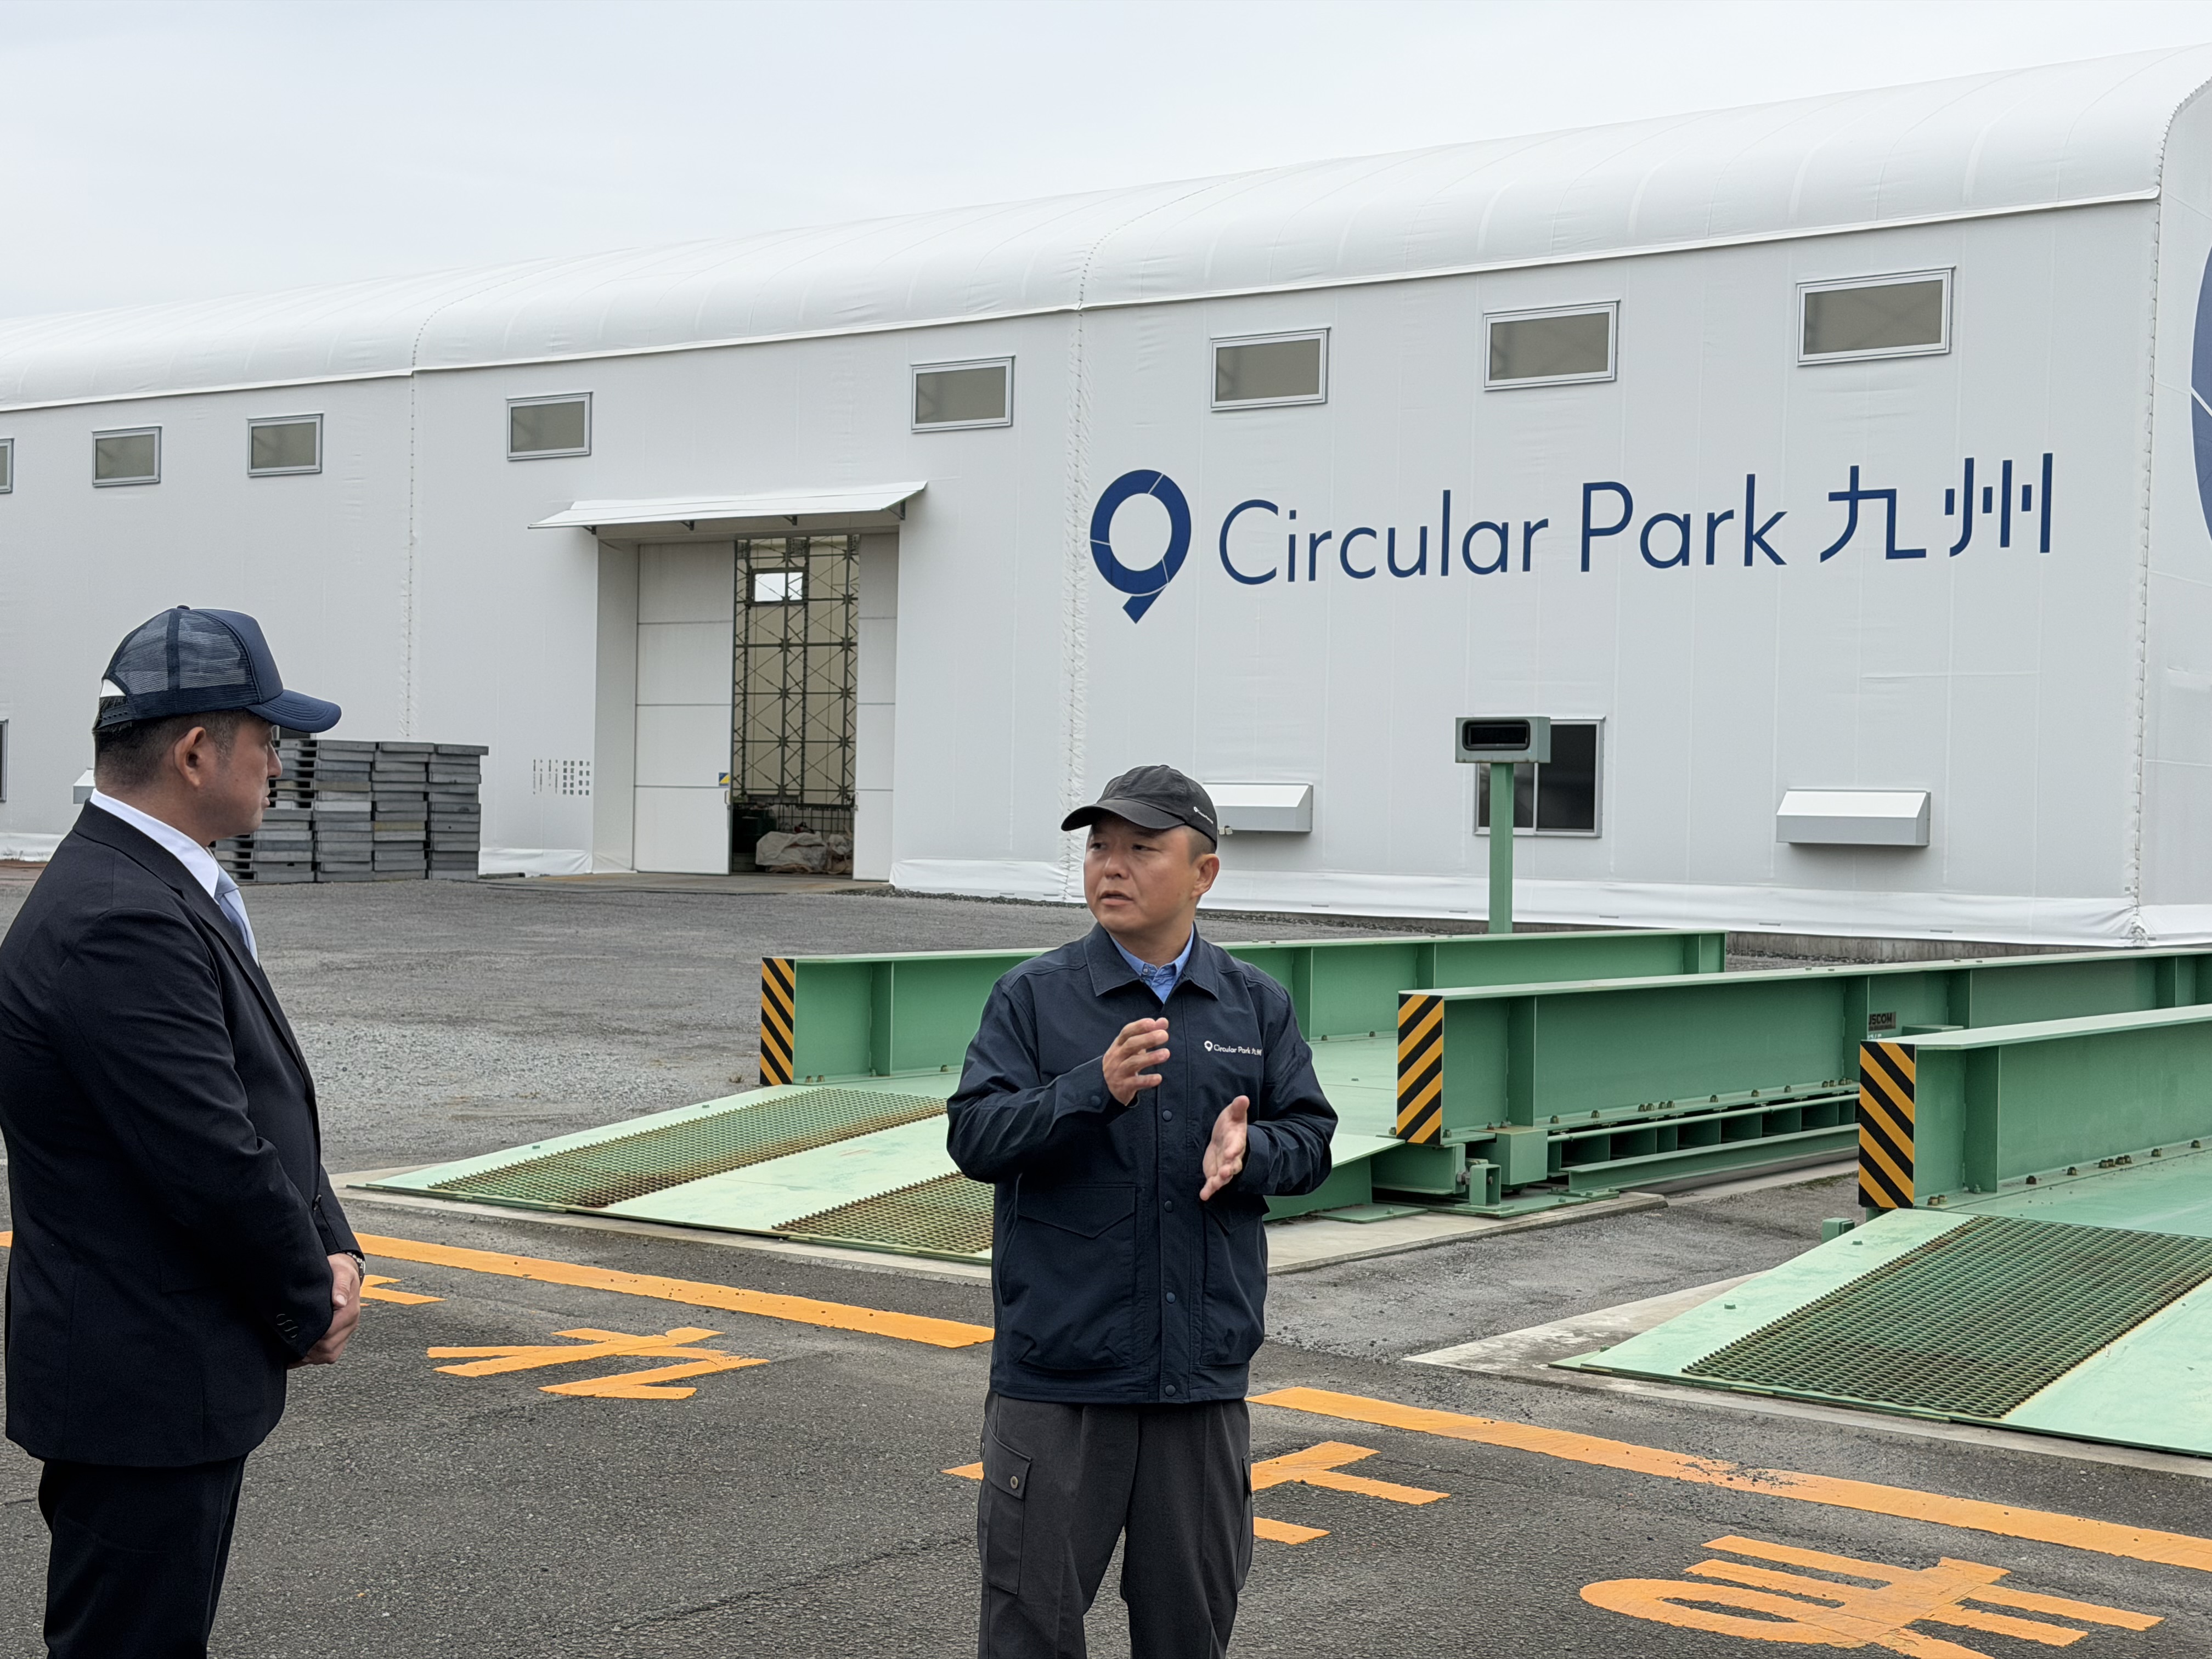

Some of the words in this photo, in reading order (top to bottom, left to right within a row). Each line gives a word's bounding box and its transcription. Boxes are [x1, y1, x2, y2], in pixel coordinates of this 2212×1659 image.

[1219, 489, 1549, 585] Circular
[1581, 473, 1787, 572] Park
[1820, 453, 2053, 562] 九州
[1214, 1044, 1237, 1053] Circular
[1237, 1046, 1251, 1054] Park
